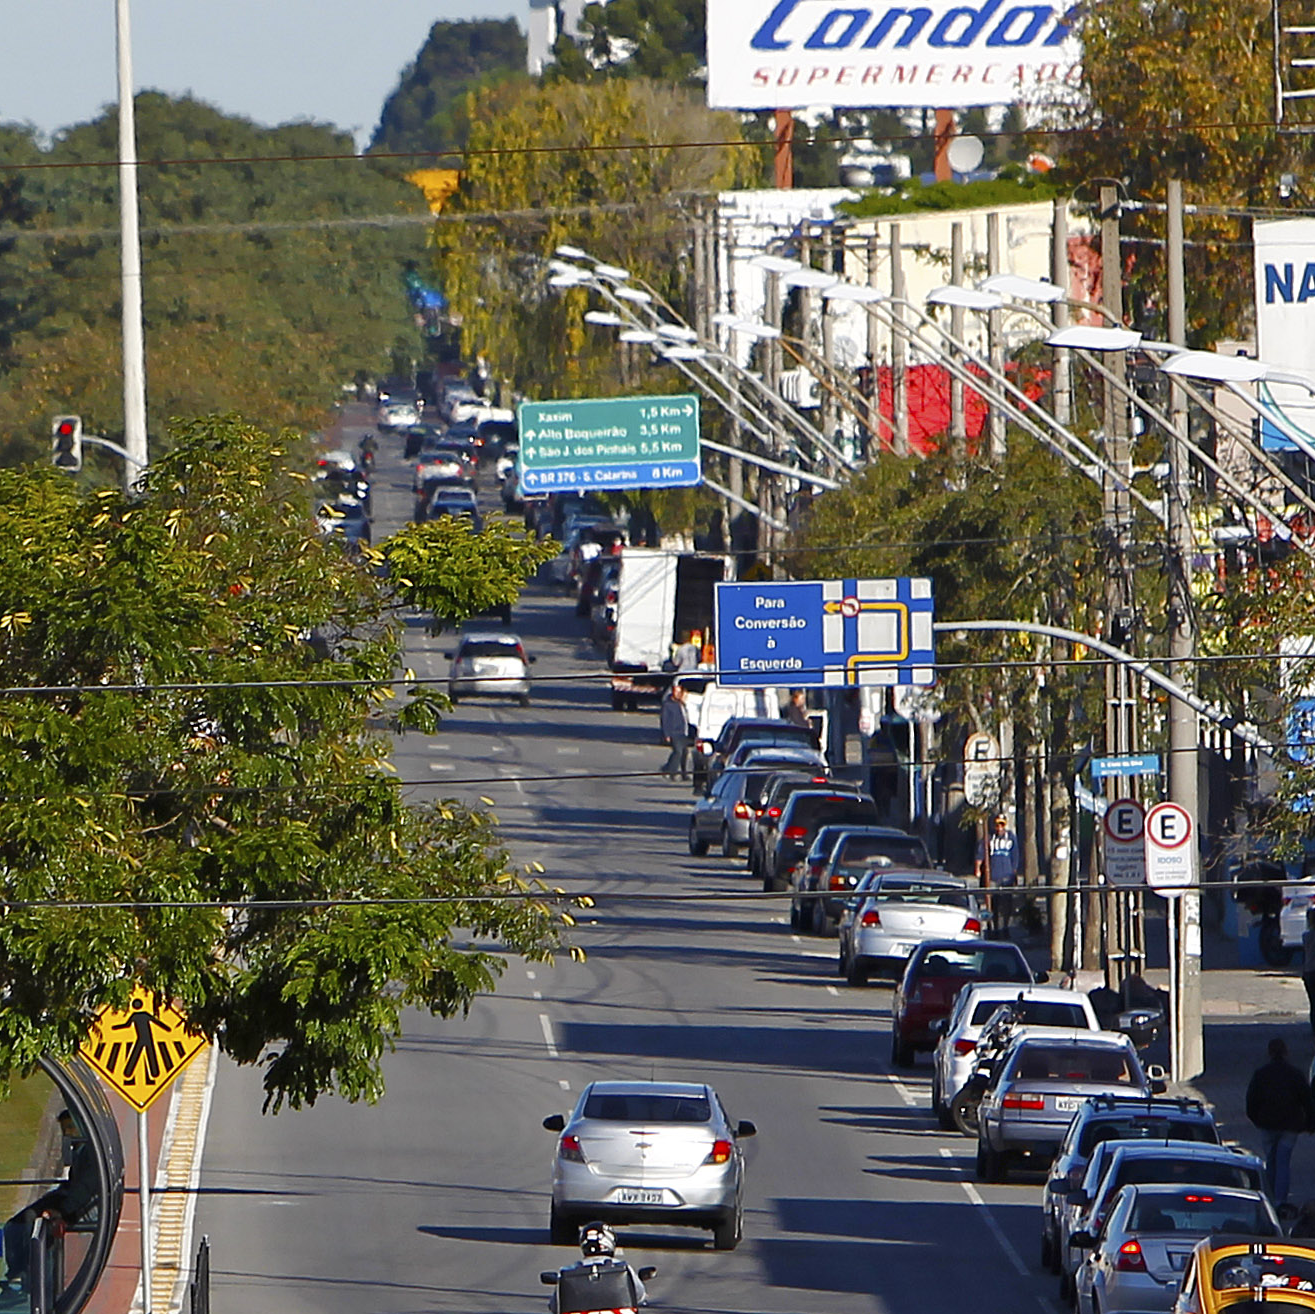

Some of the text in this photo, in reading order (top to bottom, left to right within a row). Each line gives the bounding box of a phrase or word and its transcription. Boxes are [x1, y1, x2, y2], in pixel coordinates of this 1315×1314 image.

[538, 412, 572, 422] Xaxim
[661, 406, 681, 417] Km
[538, 424, 681, 441] Alto Boqueirão 3,5 Km
[574, 445, 594, 456] dos
[597, 444, 637, 455] Pinhais
[662, 442, 683, 453] Km
[540, 472, 555, 483] BR
[595, 470, 637, 481] Catarina
[663, 466, 683, 477] Km
[755, 597, 785, 609] Para
[735, 615, 807, 629] Conversão
[767, 635, 776, 648] à
[740, 656, 803, 670] Esquerda
[1117, 808, 1134, 835] E
[1160, 814, 1176, 840] E
[1157, 856, 1182, 864] IDOSO
